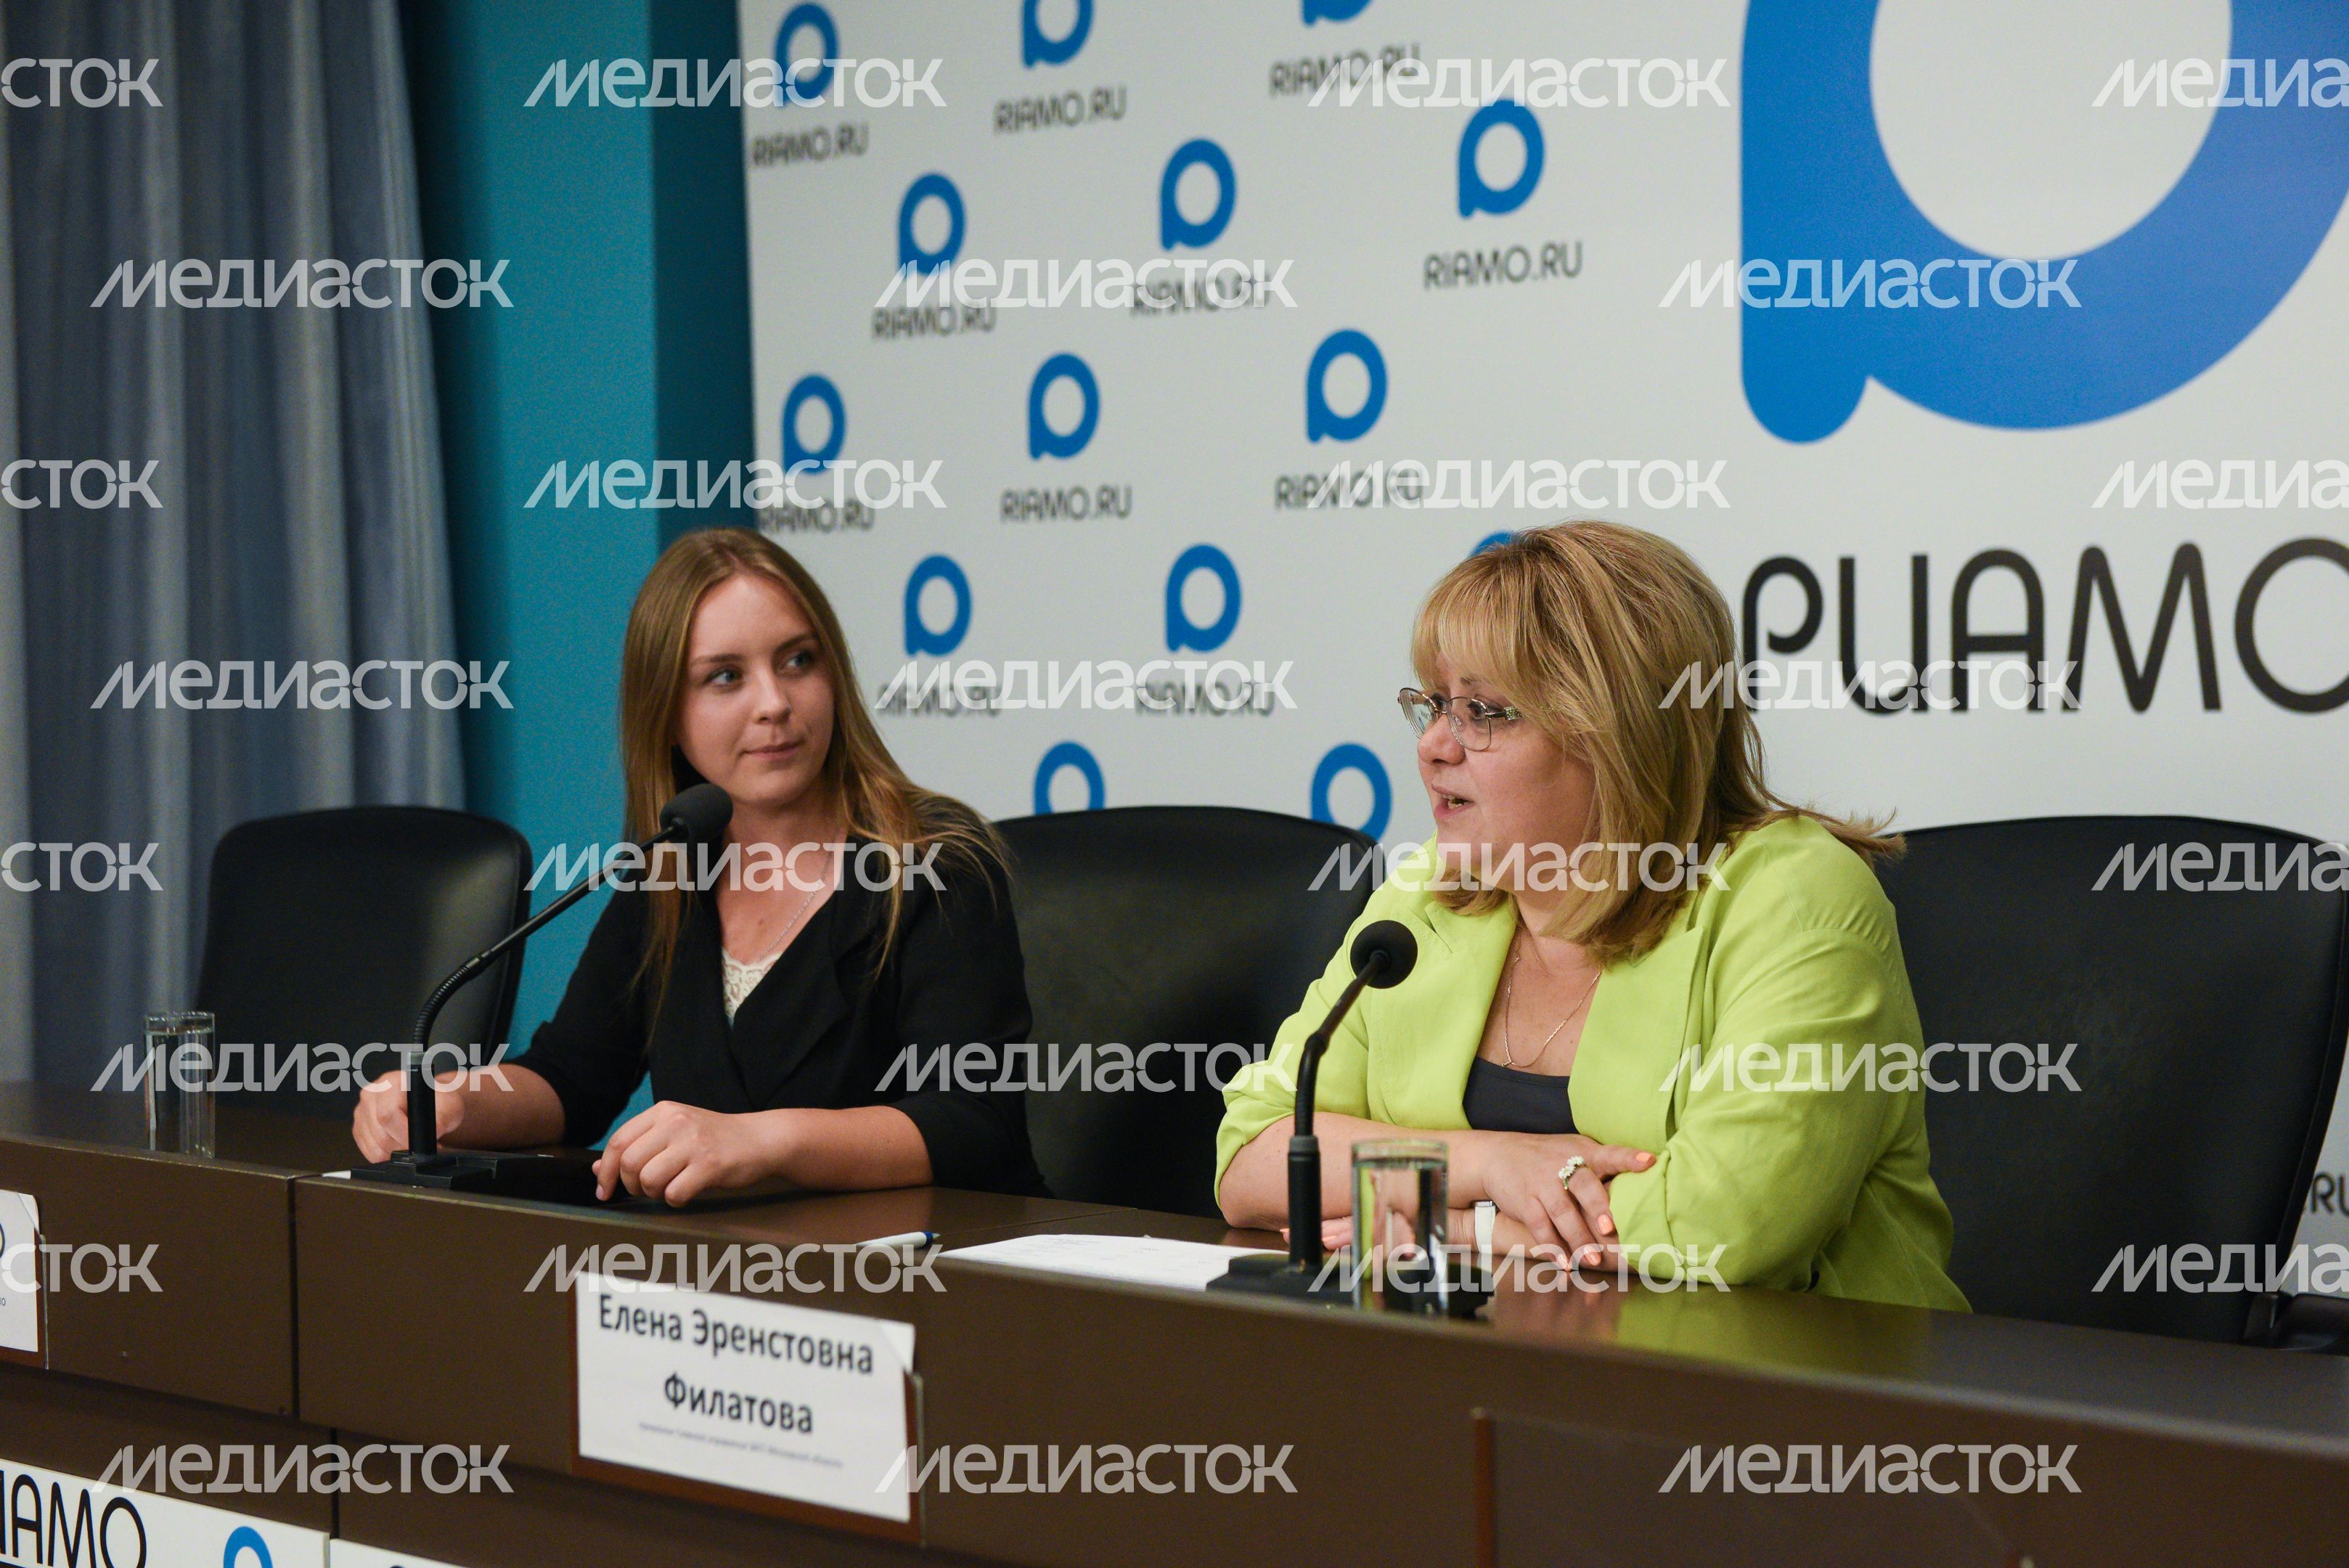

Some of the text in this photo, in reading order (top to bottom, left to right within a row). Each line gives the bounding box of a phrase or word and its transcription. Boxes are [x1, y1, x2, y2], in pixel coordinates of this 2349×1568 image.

[992, 85, 1129, 136] RIAMO.RU
[1423, 238, 1583, 290] RIAMO.RU
[999, 483, 1133, 525] RIAMO.RU
[599, 1294, 873, 1374] Елена Эренстовна
[663, 1372, 814, 1434] Филатова
[0, 1469, 147, 1568] АМО
